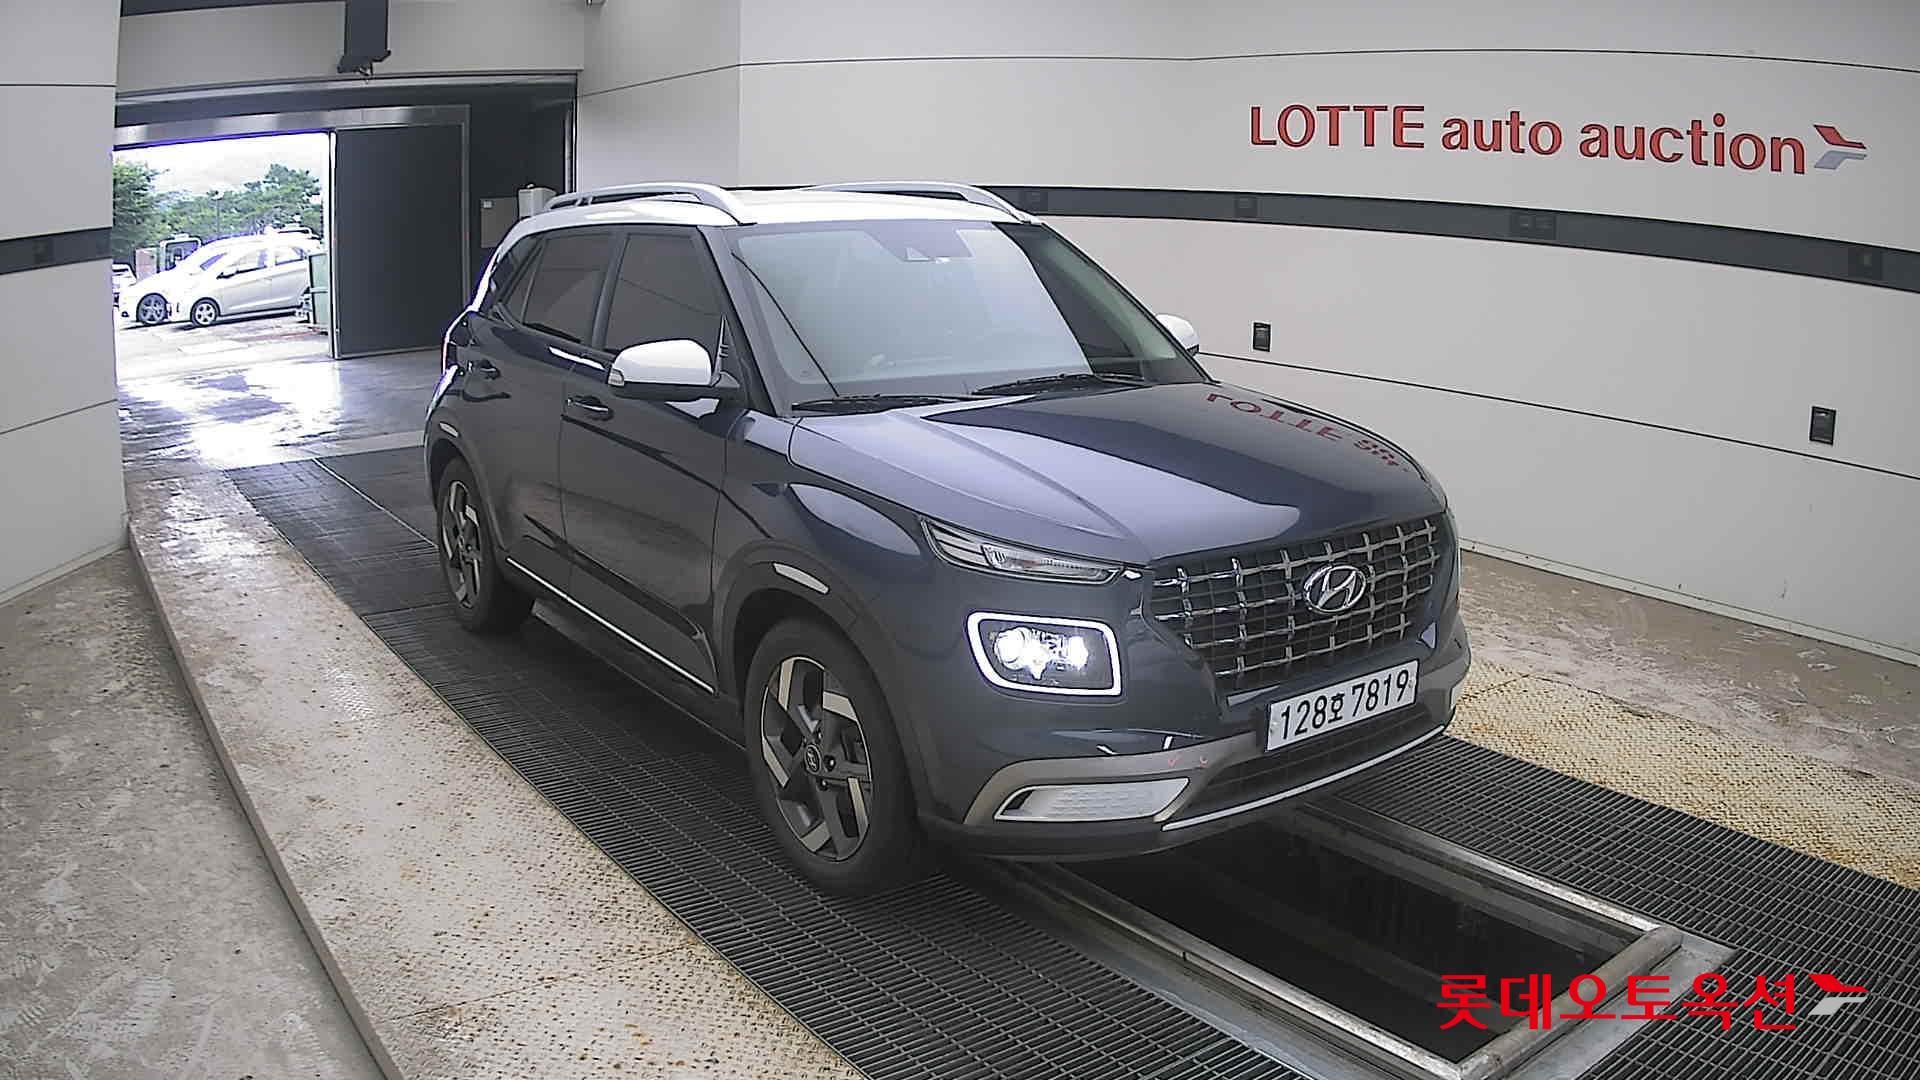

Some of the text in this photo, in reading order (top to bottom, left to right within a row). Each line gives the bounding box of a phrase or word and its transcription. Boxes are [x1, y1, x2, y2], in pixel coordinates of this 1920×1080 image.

[1249, 104, 1806, 175] LOTTE auto auction
